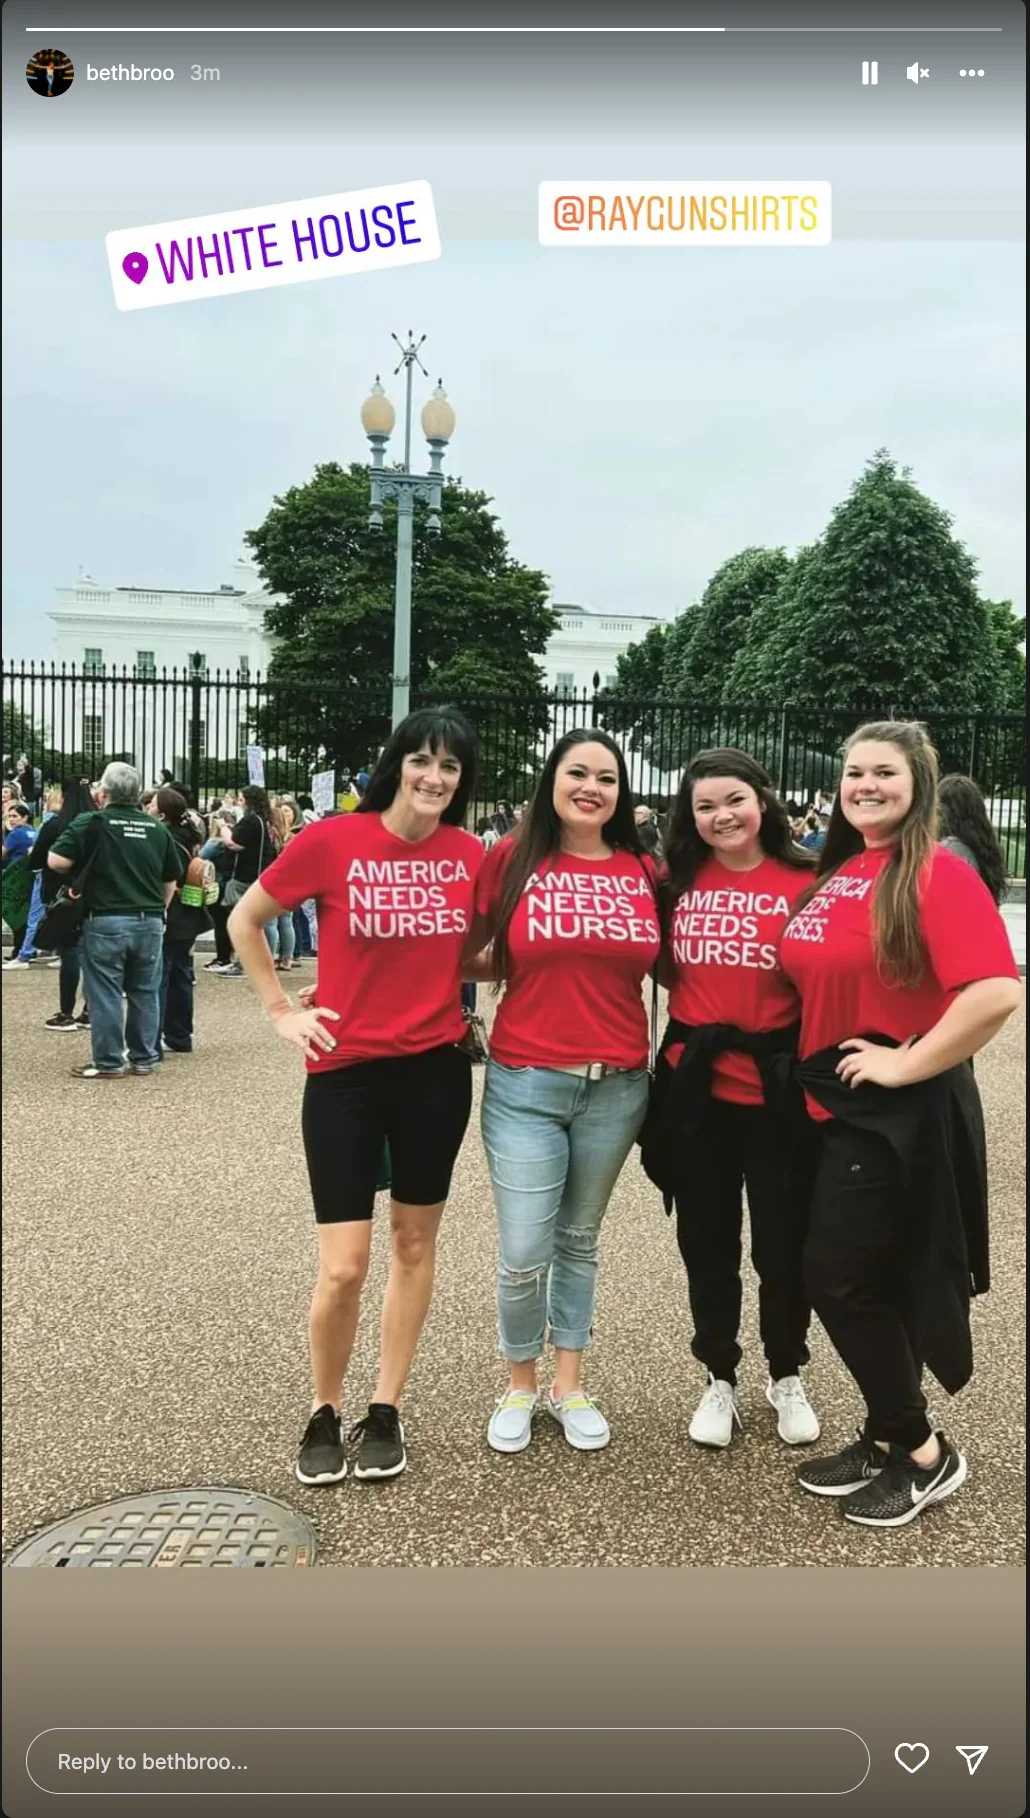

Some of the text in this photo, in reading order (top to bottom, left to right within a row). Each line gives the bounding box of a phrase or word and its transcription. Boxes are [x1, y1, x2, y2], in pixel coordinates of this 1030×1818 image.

[346, 858, 471, 884] AMERICA
[348, 885, 447, 910] NEEDS
[523, 871, 653, 899] AMERICA
[815, 876, 872, 900] ERICA
[527, 892, 636, 916] NEEDS
[674, 890, 790, 917] AMERICA
[674, 913, 758, 939] NEEDS
[782, 916, 828, 943] RSES.
